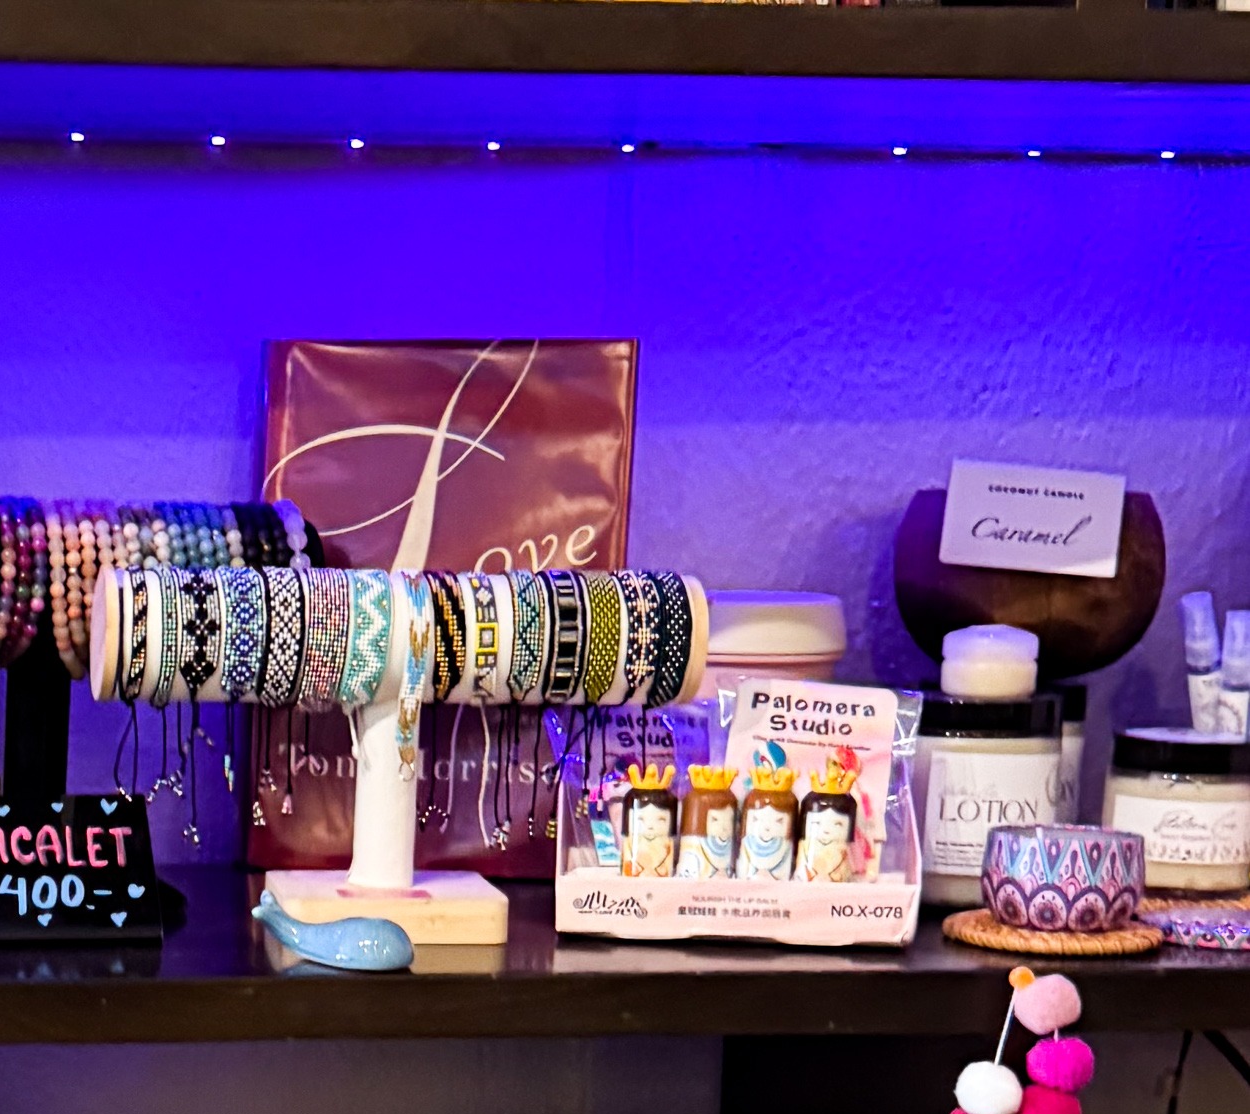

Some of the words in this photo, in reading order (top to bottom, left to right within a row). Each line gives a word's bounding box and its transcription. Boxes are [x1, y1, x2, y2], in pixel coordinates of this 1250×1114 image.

[971, 515, 1093, 545] Caramel
[751, 692, 876, 719] Palomera
[769, 713, 853, 736] Studio
[939, 798, 1039, 823] LOTION
